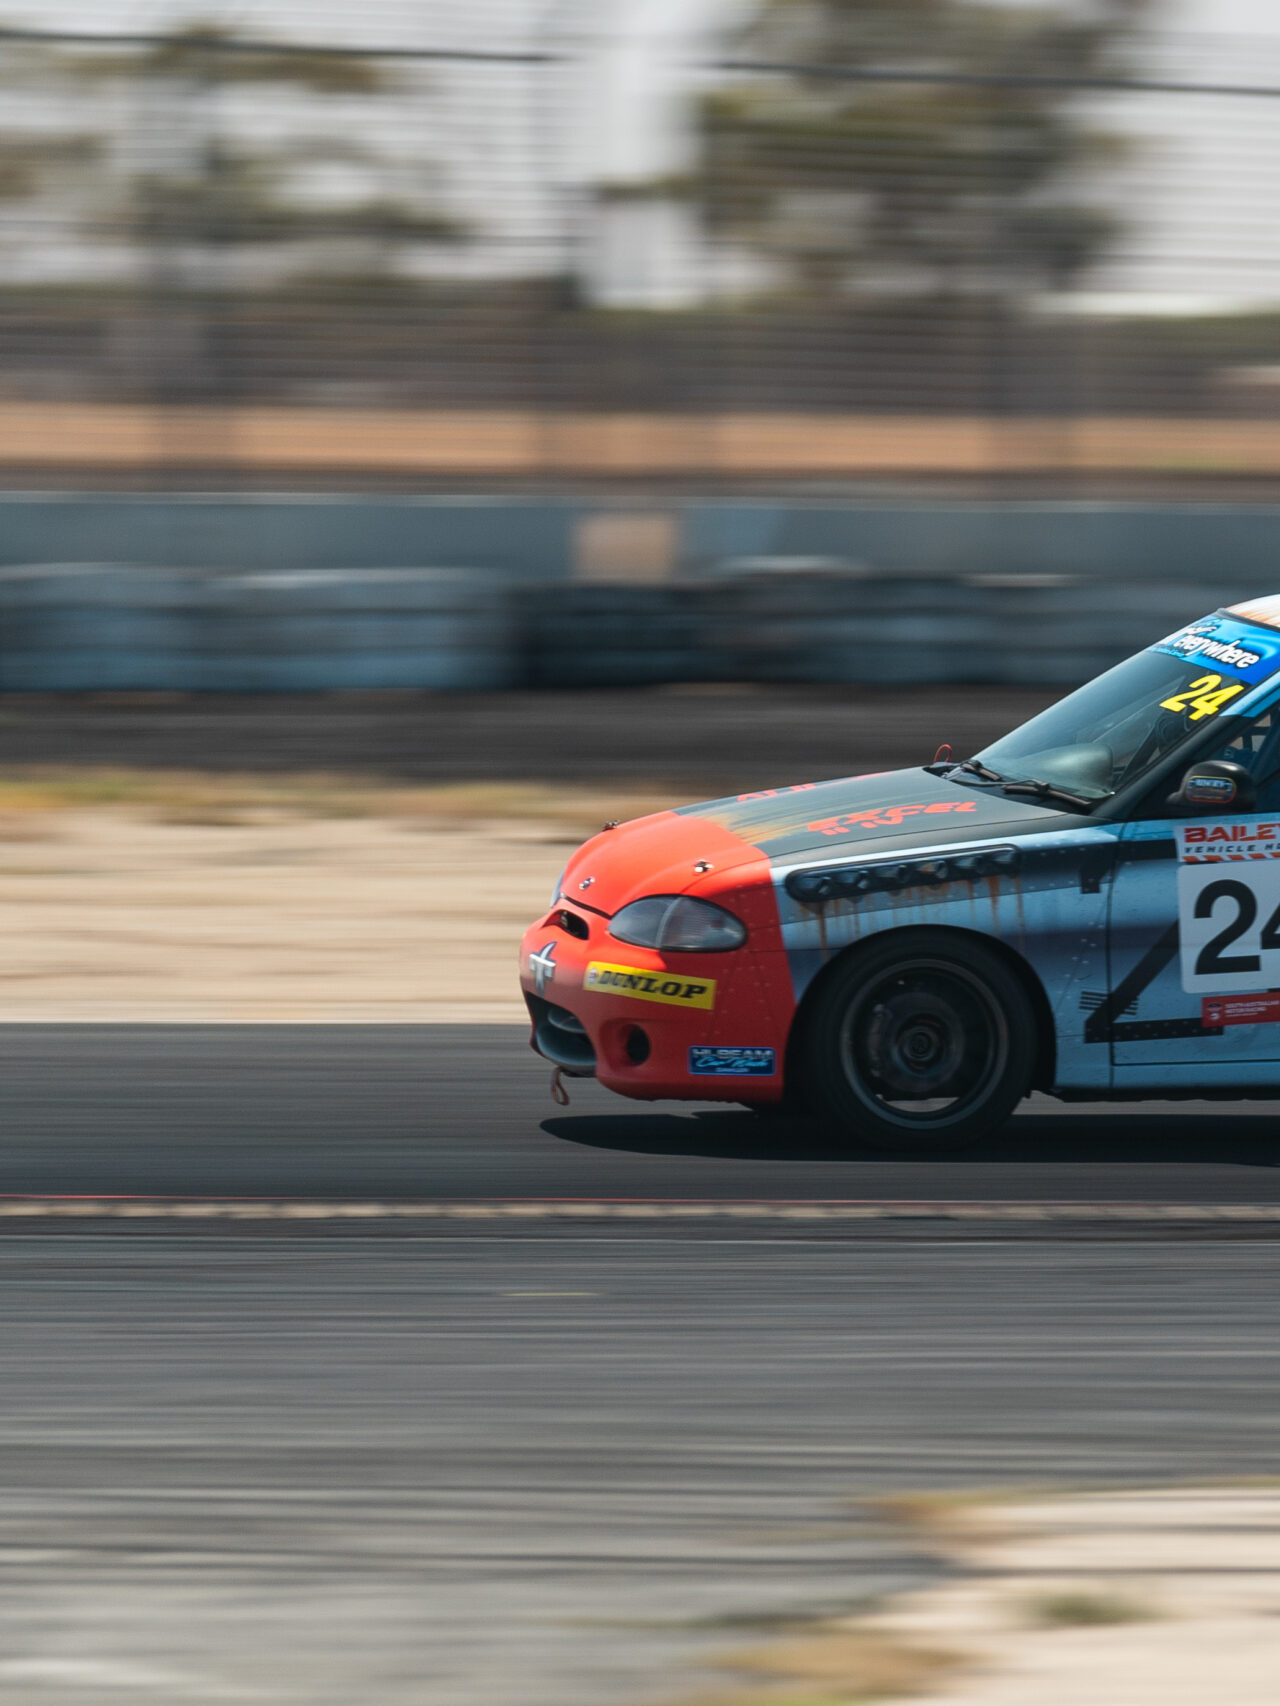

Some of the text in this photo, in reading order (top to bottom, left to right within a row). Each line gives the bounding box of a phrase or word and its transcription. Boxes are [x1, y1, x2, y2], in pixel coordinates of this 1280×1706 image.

[1159, 674, 1244, 720] 24
[1185, 844, 1256, 854] VEHICLE
[597, 970, 707, 999] DUNLOP
